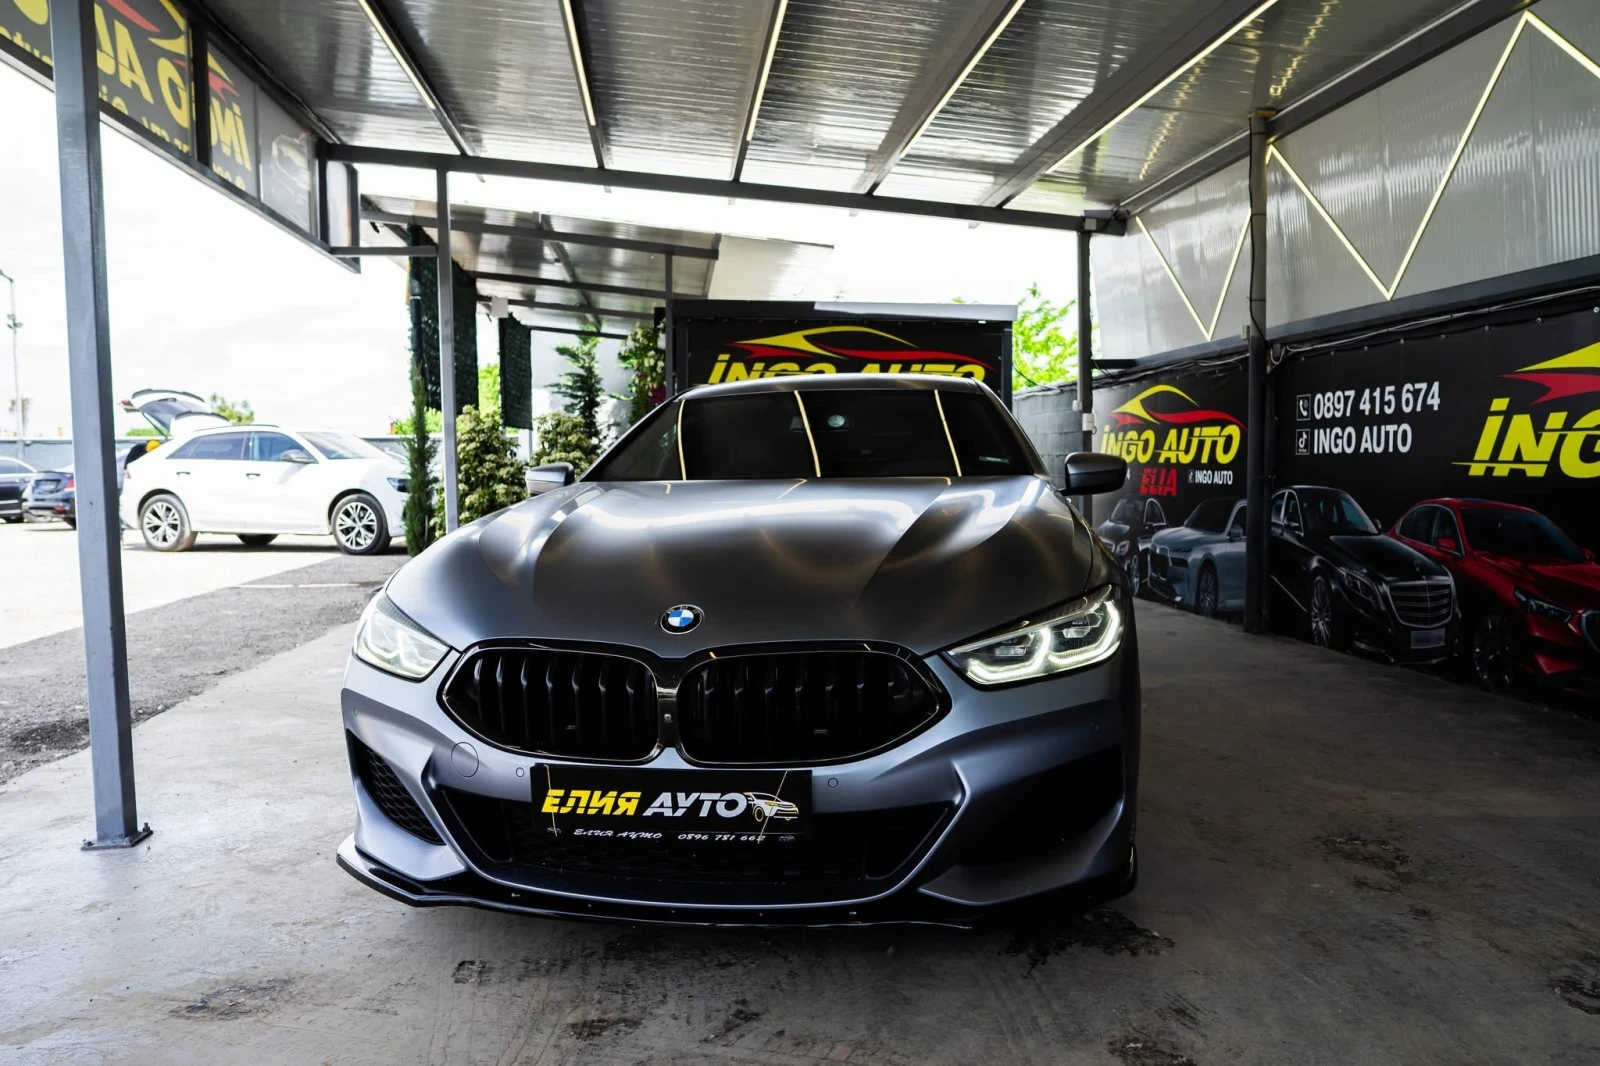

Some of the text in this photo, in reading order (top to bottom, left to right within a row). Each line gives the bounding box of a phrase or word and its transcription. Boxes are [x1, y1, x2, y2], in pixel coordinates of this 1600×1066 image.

[1313, 381, 1441, 420] 0897 415 674
[1157, 424, 1241, 465] AUTO
[1313, 423, 1413, 454] INGO AUTO
[1194, 469, 1234, 485] INGO AUTO
[541, 788, 748, 818] ЕЛИЯ АУТО
[677, 833, 709, 841] 0896
